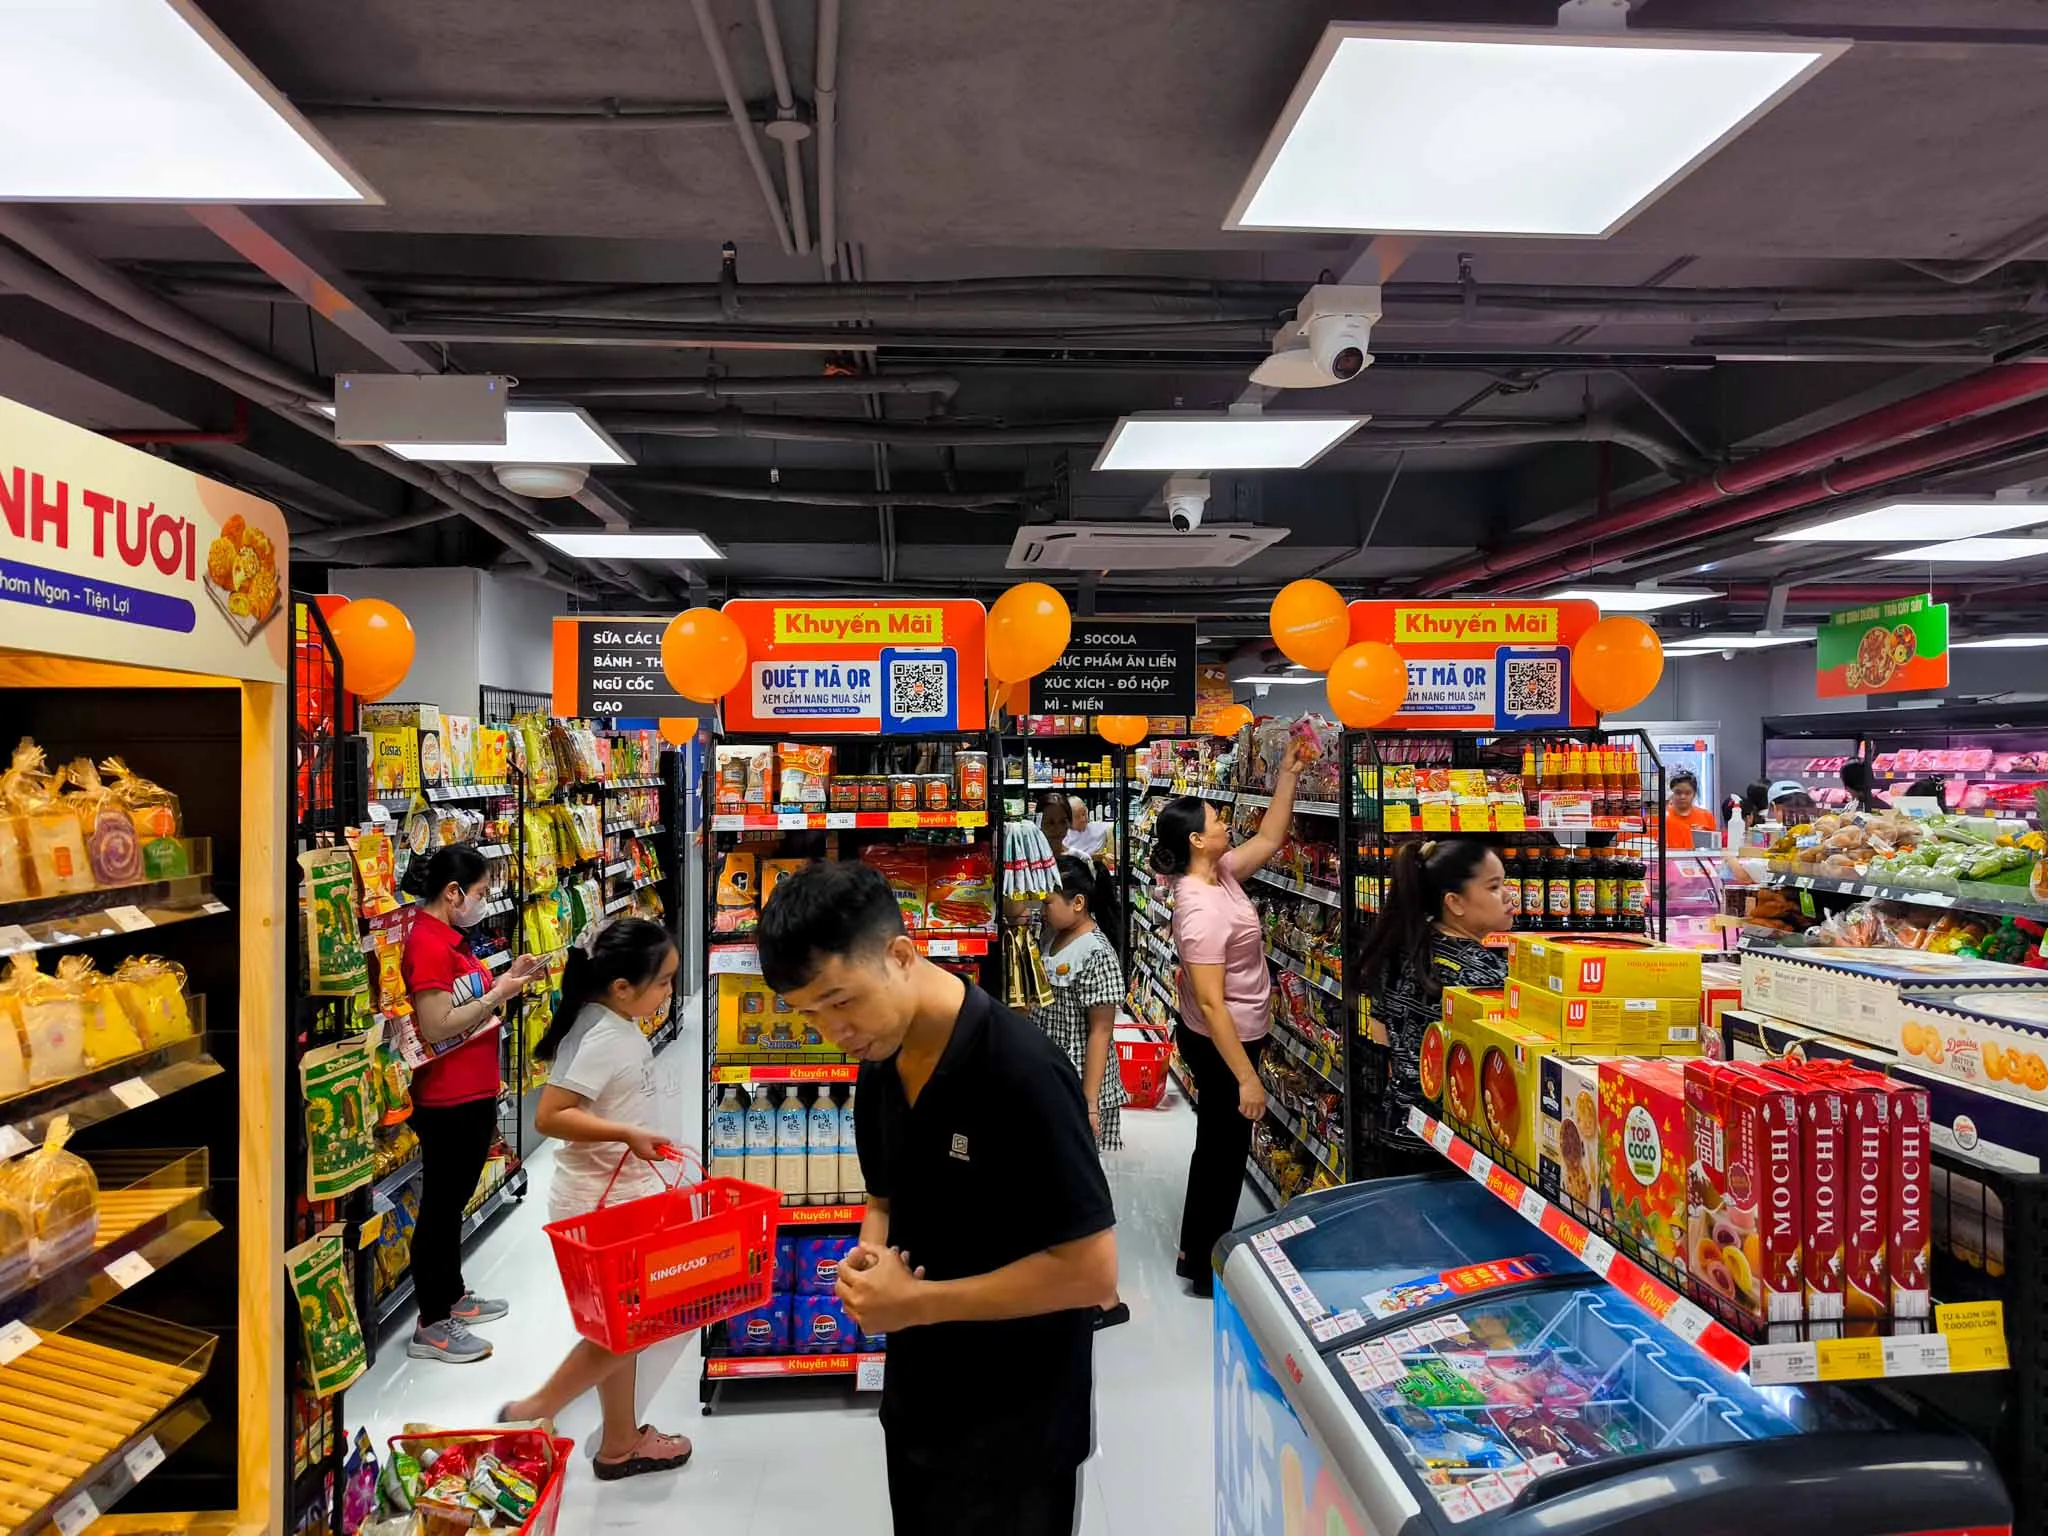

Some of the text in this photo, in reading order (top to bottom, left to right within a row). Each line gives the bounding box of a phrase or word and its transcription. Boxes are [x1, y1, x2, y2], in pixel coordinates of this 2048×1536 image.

[83, 489, 196, 581] TƯƠI
[34, 577, 70, 604] Ngon
[83, 588, 110, 612] Tiện
[114, 593, 129, 616] Lợi
[786, 612, 932, 639] Khuyến Mãi
[1406, 613, 1548, 639] Khuyến Mãi
[593, 631, 621, 644] SỮA
[625, 632, 652, 644] CÁC
[1084, 634, 1137, 644] SOCOLA
[593, 654, 632, 667] BÁNH
[645, 657, 663, 667] TH
[1054, 655, 1081, 669] HỰC
[1126, 654, 1145, 667] ĂN
[593, 675, 654, 690] NGŨ CỐC
[762, 664, 870, 690] QUÉT MÃ QR
[1407, 663, 1486, 687] ÉT MÃ QR
[1045, 676, 1071, 688] XÚC
[1075, 676, 1105, 688] XÍCH
[1141, 676, 1169, 692] HỘP
[762, 694, 780, 705] XEM
[805, 693, 829, 704] NANG
[832, 693, 849, 704] MUA
[1045, 697, 1059, 710] MÌ
[1072, 696, 1103, 710] MIẾN
[1422, 691, 1445, 702] NANG
[1449, 691, 1466, 701] MUA
[593, 701, 622, 714] GẠO
[1583, 962, 1601, 983] LU
[1570, 1004, 1584, 1020] LU
[790, 1068, 849, 1080] Khuyến Mãi
[1631, 1126, 1651, 1142] TOP
[1628, 1143, 1657, 1160] COCO
[1771, 1128, 1791, 1235] MOCHI
[1816, 1127, 1834, 1234] MOCHI
[1860, 1125, 1879, 1232] MOCHI
[1902, 1125, 1920, 1232] MOCHI
[792, 1208, 852, 1221] Khuyến Mãi
[814, 1323, 837, 1331] PEPSI
[708, 1362, 728, 1375] Mãi
[788, 1356, 849, 1371] Khuyến Mãi
